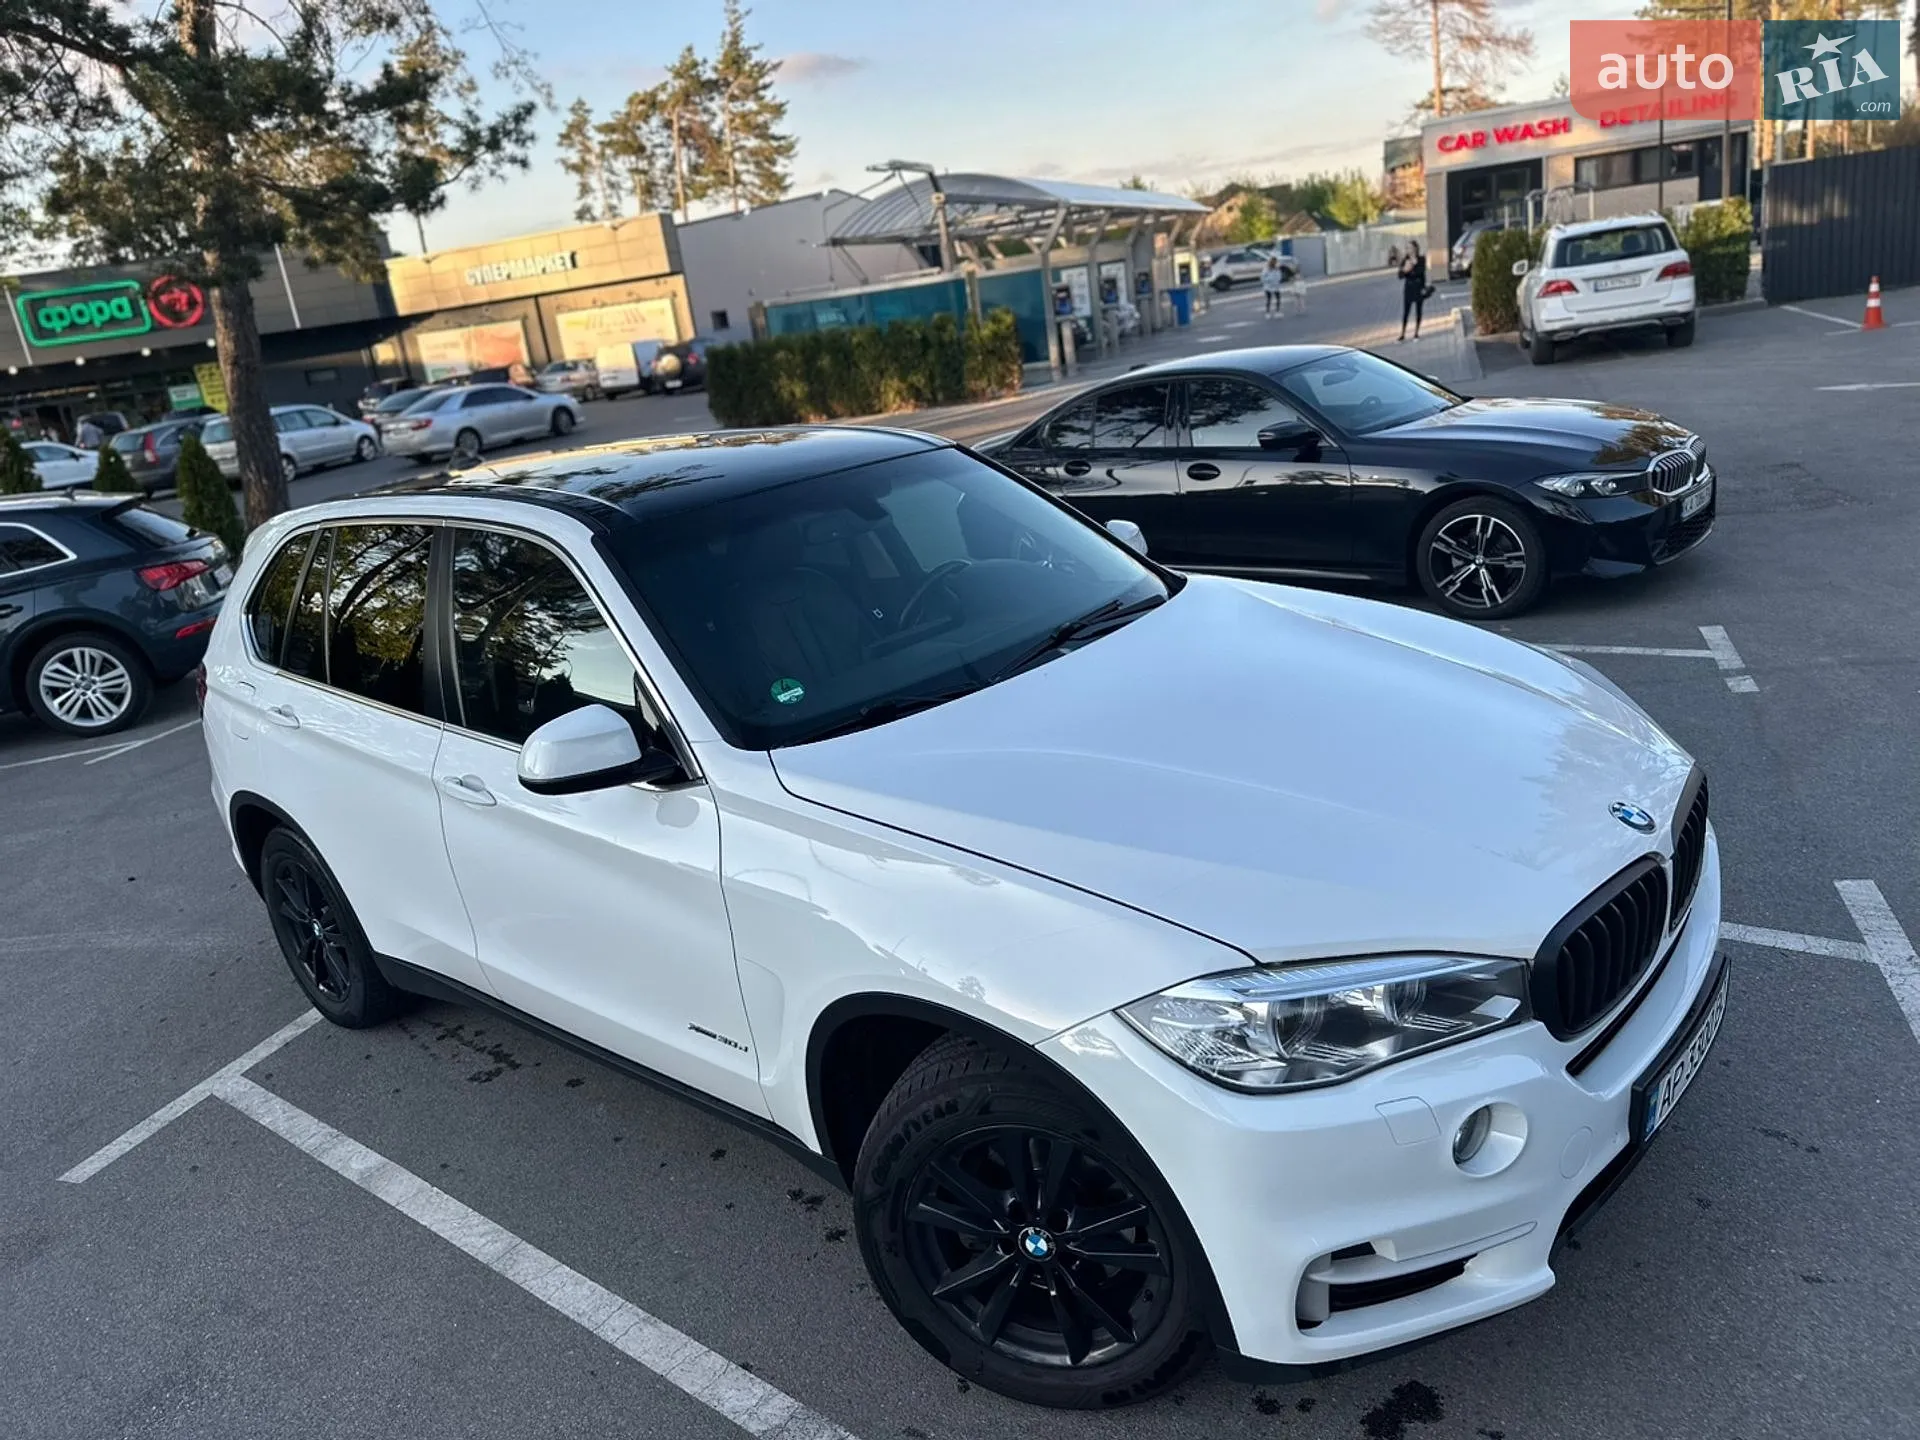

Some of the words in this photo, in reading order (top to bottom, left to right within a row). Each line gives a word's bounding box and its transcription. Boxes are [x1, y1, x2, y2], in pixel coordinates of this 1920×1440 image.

[1437, 130, 1487, 152] CAR
[1492, 117, 1570, 144] WASH
[465, 252, 577, 286] СУПЕРМАРКЕТ
